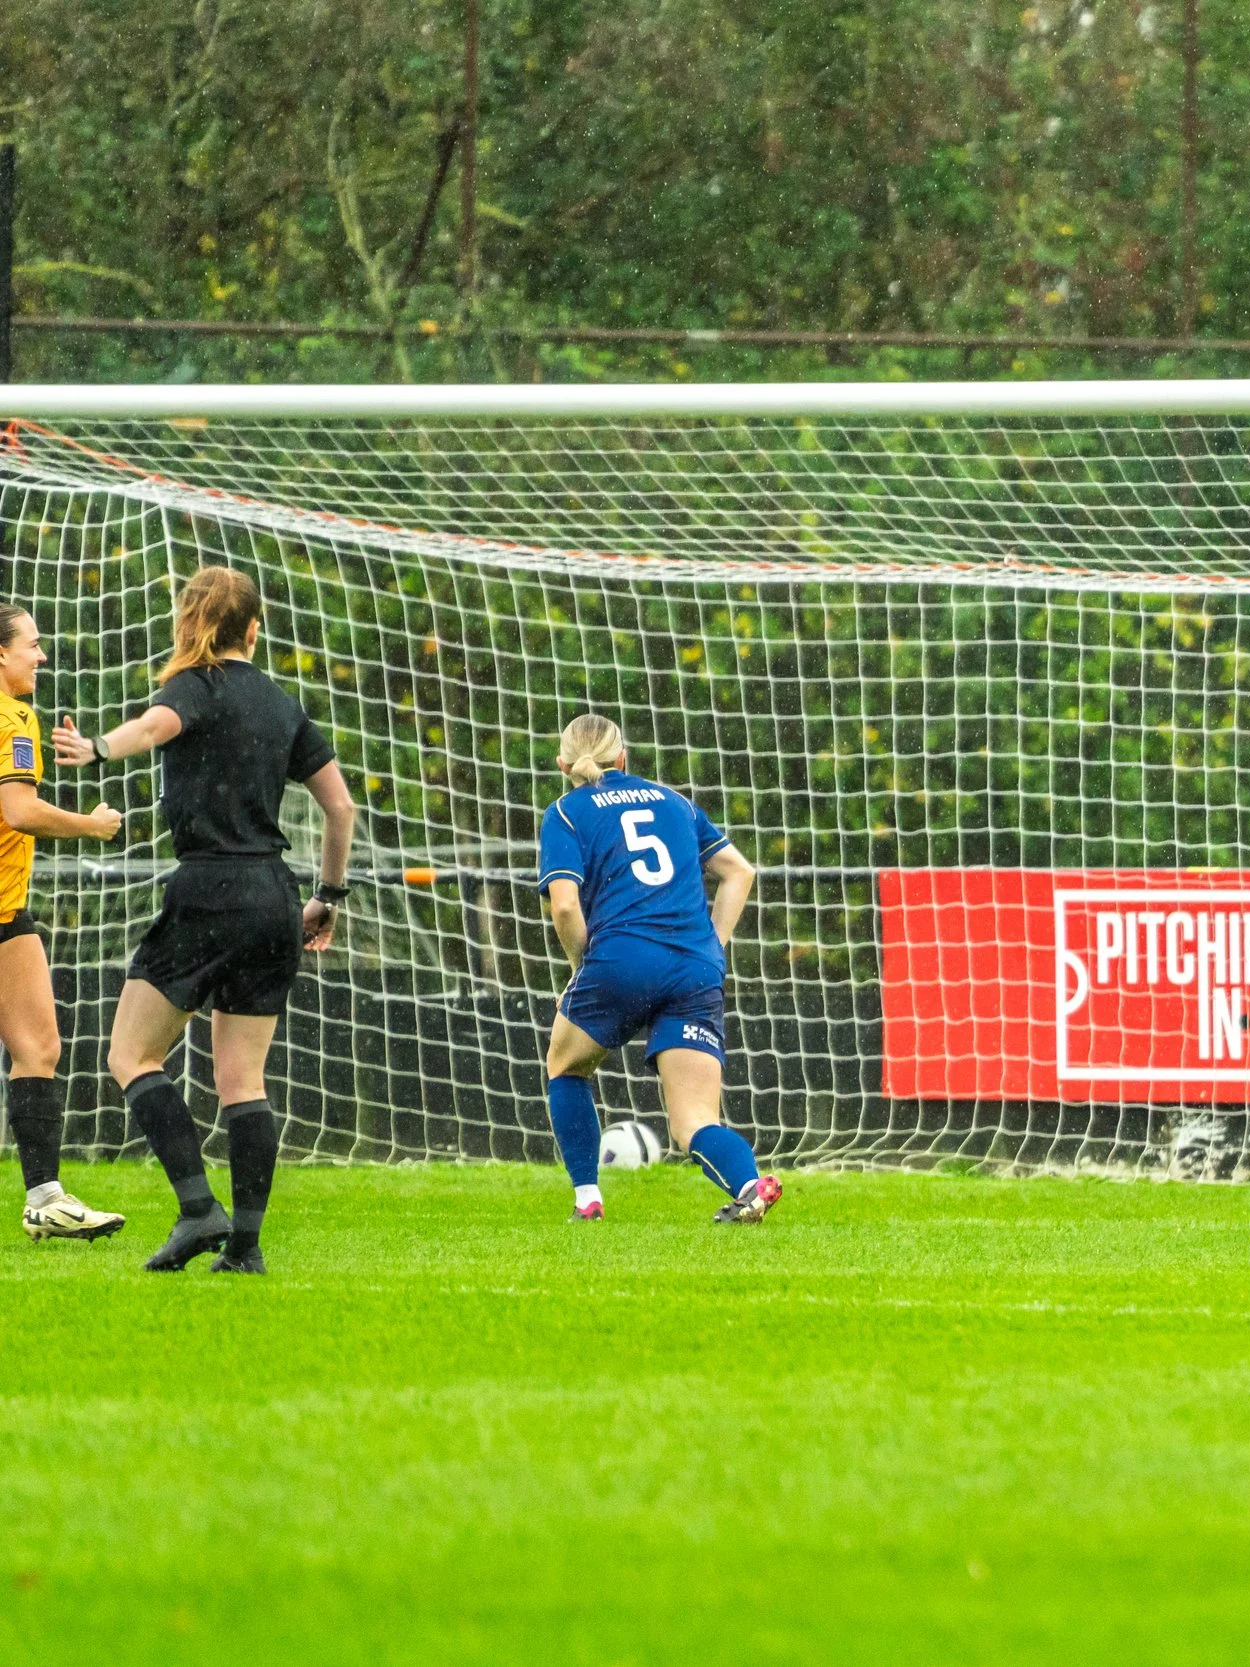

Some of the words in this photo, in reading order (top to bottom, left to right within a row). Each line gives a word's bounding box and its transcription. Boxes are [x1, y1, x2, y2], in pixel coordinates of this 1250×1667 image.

[591, 789, 666, 808] HIGHMAN
[620, 809, 675, 886] 5
[1199, 987, 1242, 1060] IN
